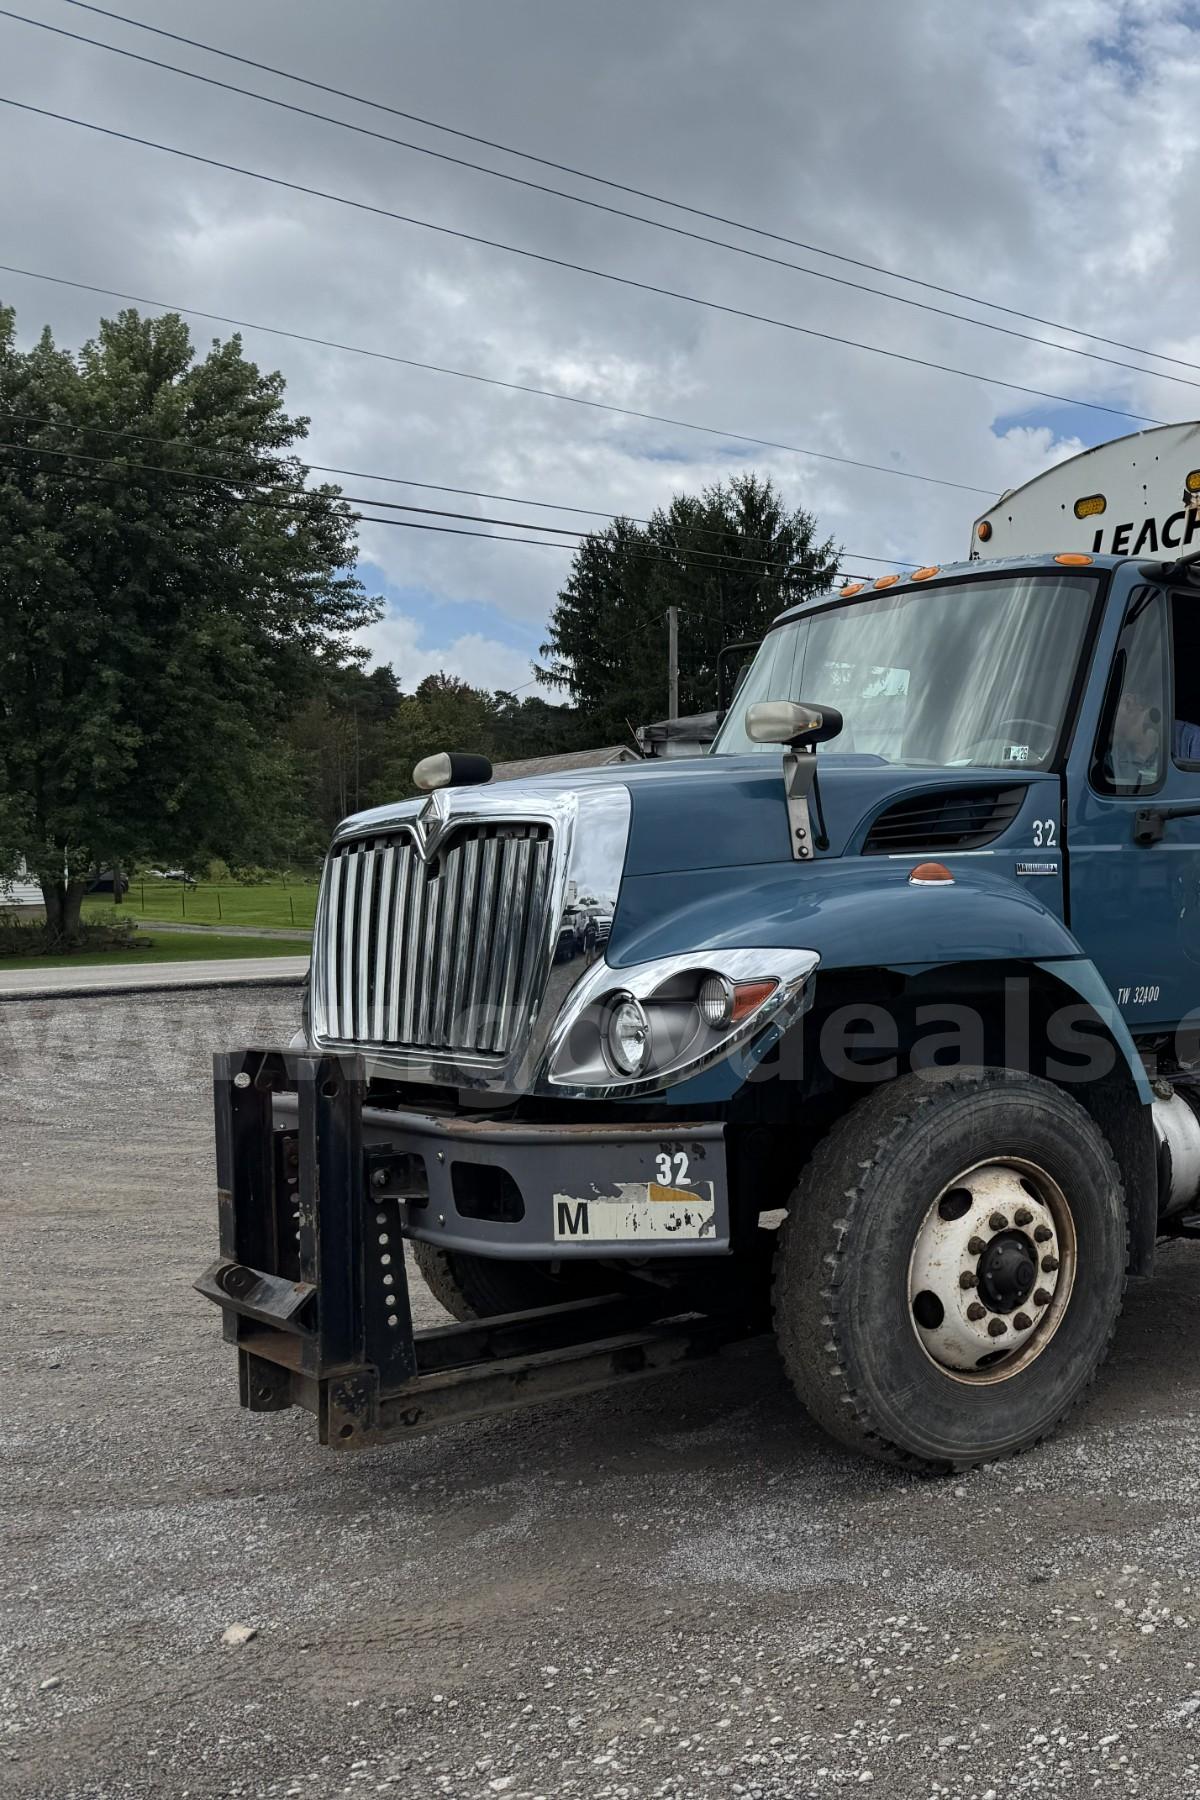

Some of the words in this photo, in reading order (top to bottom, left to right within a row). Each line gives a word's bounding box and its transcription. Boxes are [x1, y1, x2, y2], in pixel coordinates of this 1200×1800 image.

[1033, 819, 1056, 846] 32
[1117, 987, 1131, 1005] TW
[655, 1152, 692, 1185] 32
[557, 1202, 589, 1235] M
